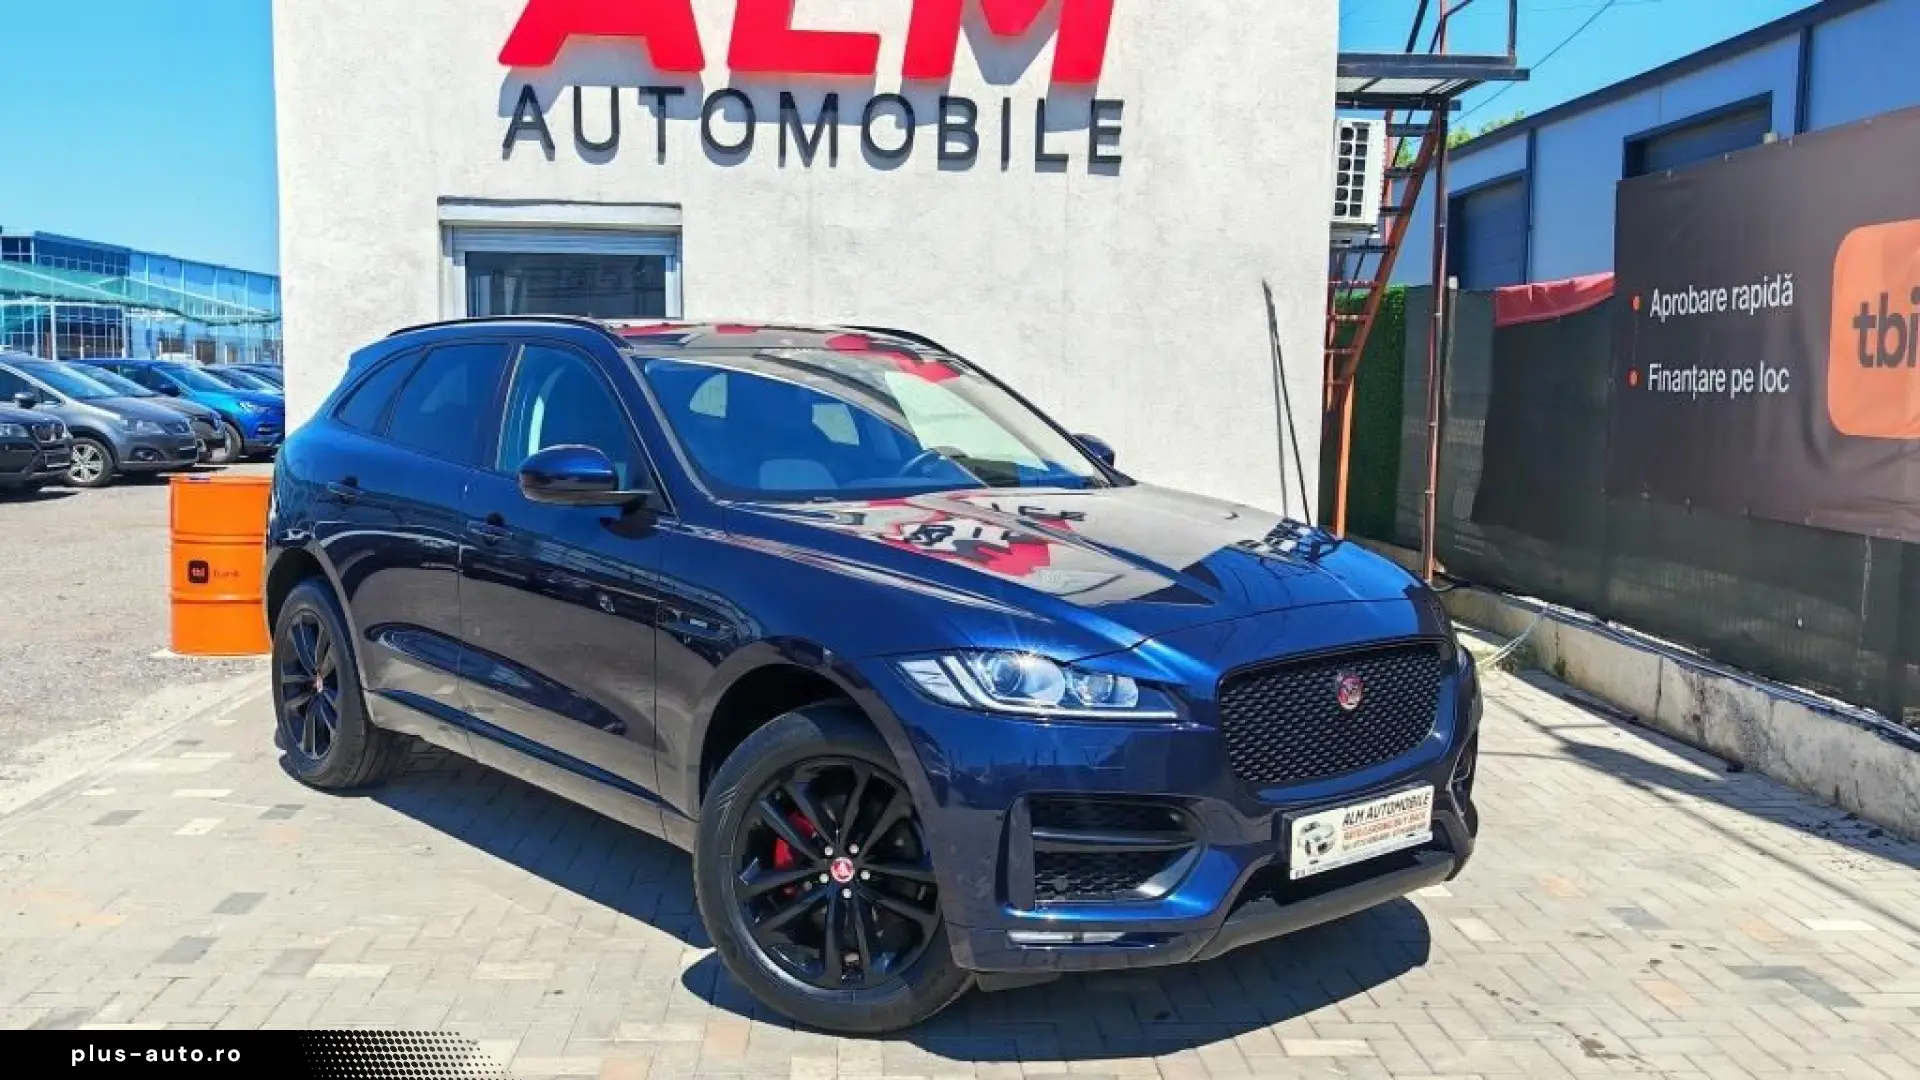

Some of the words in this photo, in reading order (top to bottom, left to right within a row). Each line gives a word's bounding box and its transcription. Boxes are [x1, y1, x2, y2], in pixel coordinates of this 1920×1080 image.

[502, 83, 1125, 172] AUTOMOBILE
[1650, 285, 1727, 323] Aprobare
[1731, 273, 1794, 315] rapidă
[1853, 286, 1920, 369] tbi
[1648, 363, 1726, 400] Finanțare
[1730, 369, 1754, 399] pe
[1759, 361, 1790, 393] loc
[1342, 809, 1363, 826] ALM
[1367, 792, 1430, 819] AUTOMOBILE
